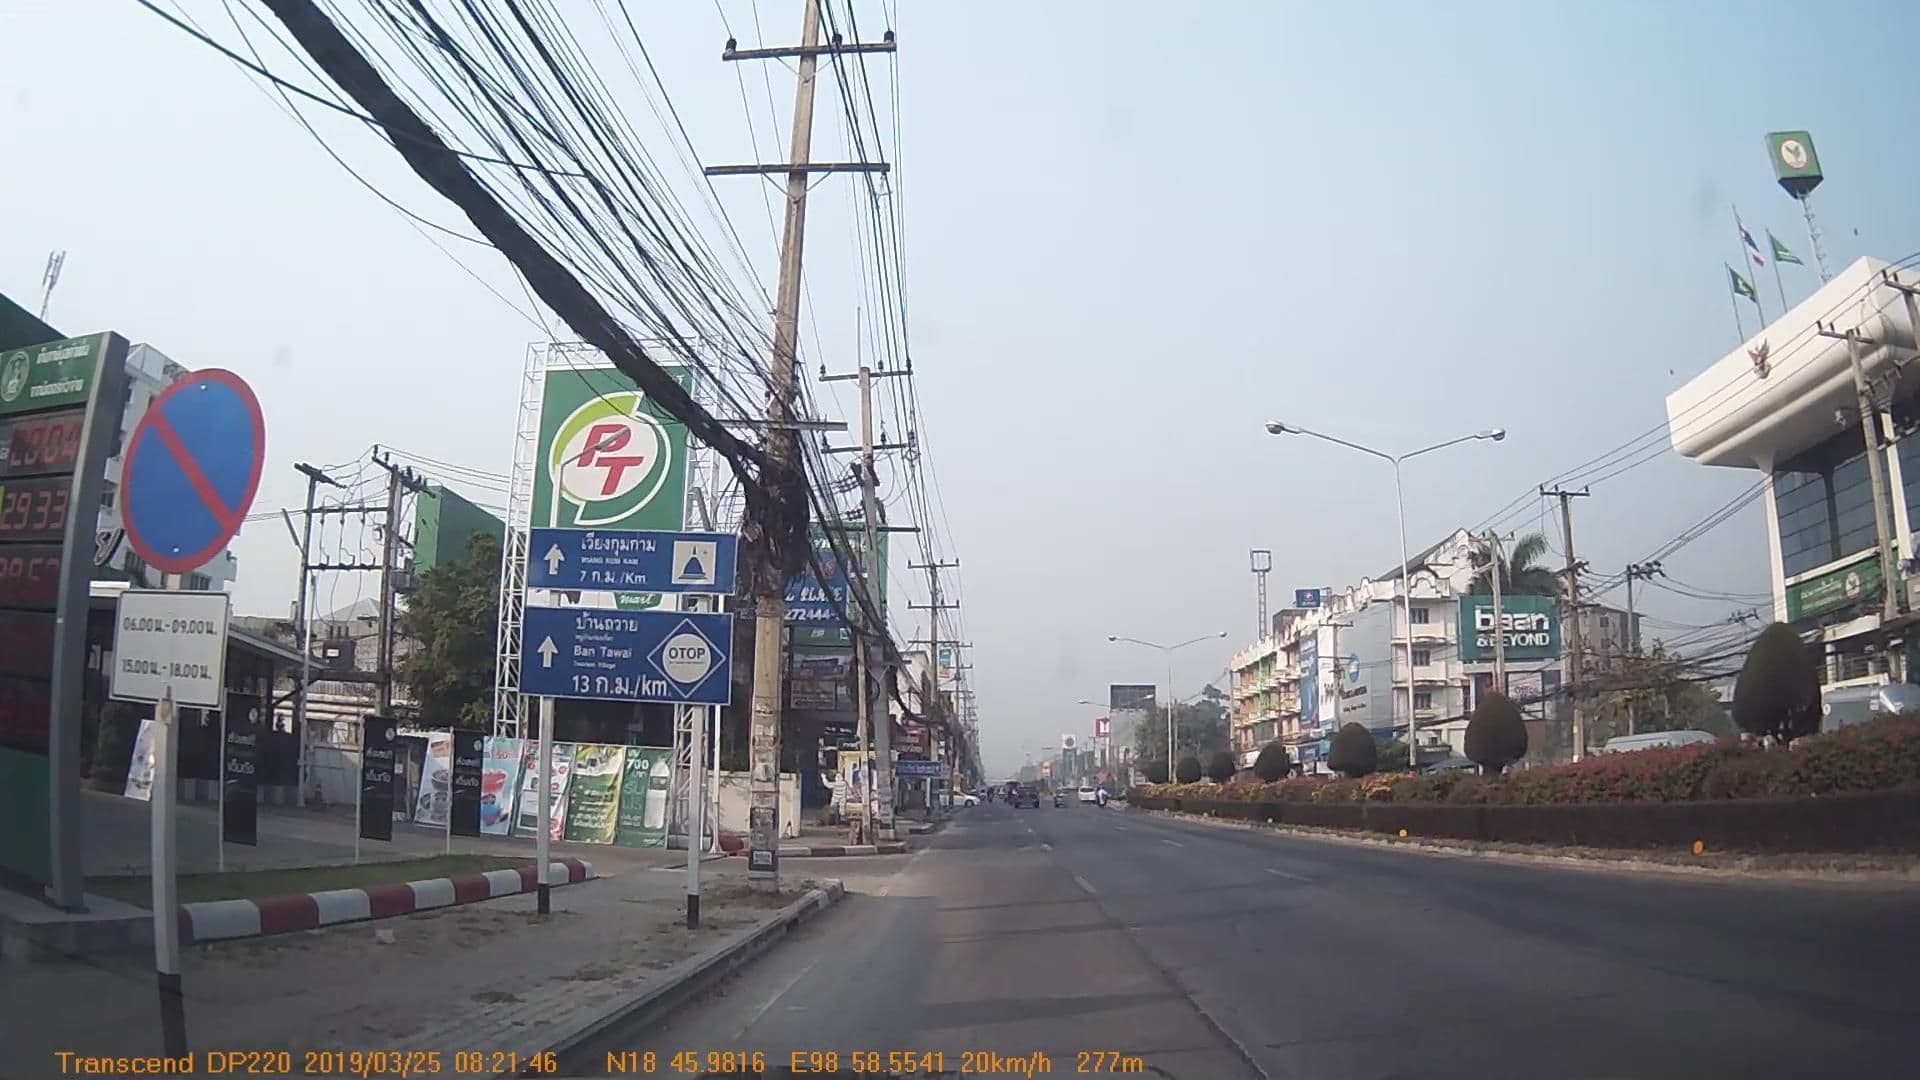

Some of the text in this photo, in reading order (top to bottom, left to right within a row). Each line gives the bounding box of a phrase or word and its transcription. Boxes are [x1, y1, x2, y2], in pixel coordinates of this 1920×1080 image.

[577, 423, 644, 496] PT
[581, 532, 657, 557] เวียงกุมกาม
[580, 570, 587, 583] 7
[575, 611, 639, 633] บ้านถวาย
[573, 644, 633, 659] Ban Tawai
[668, 647, 706, 660] OTOP
[572, 674, 590, 694] 13
